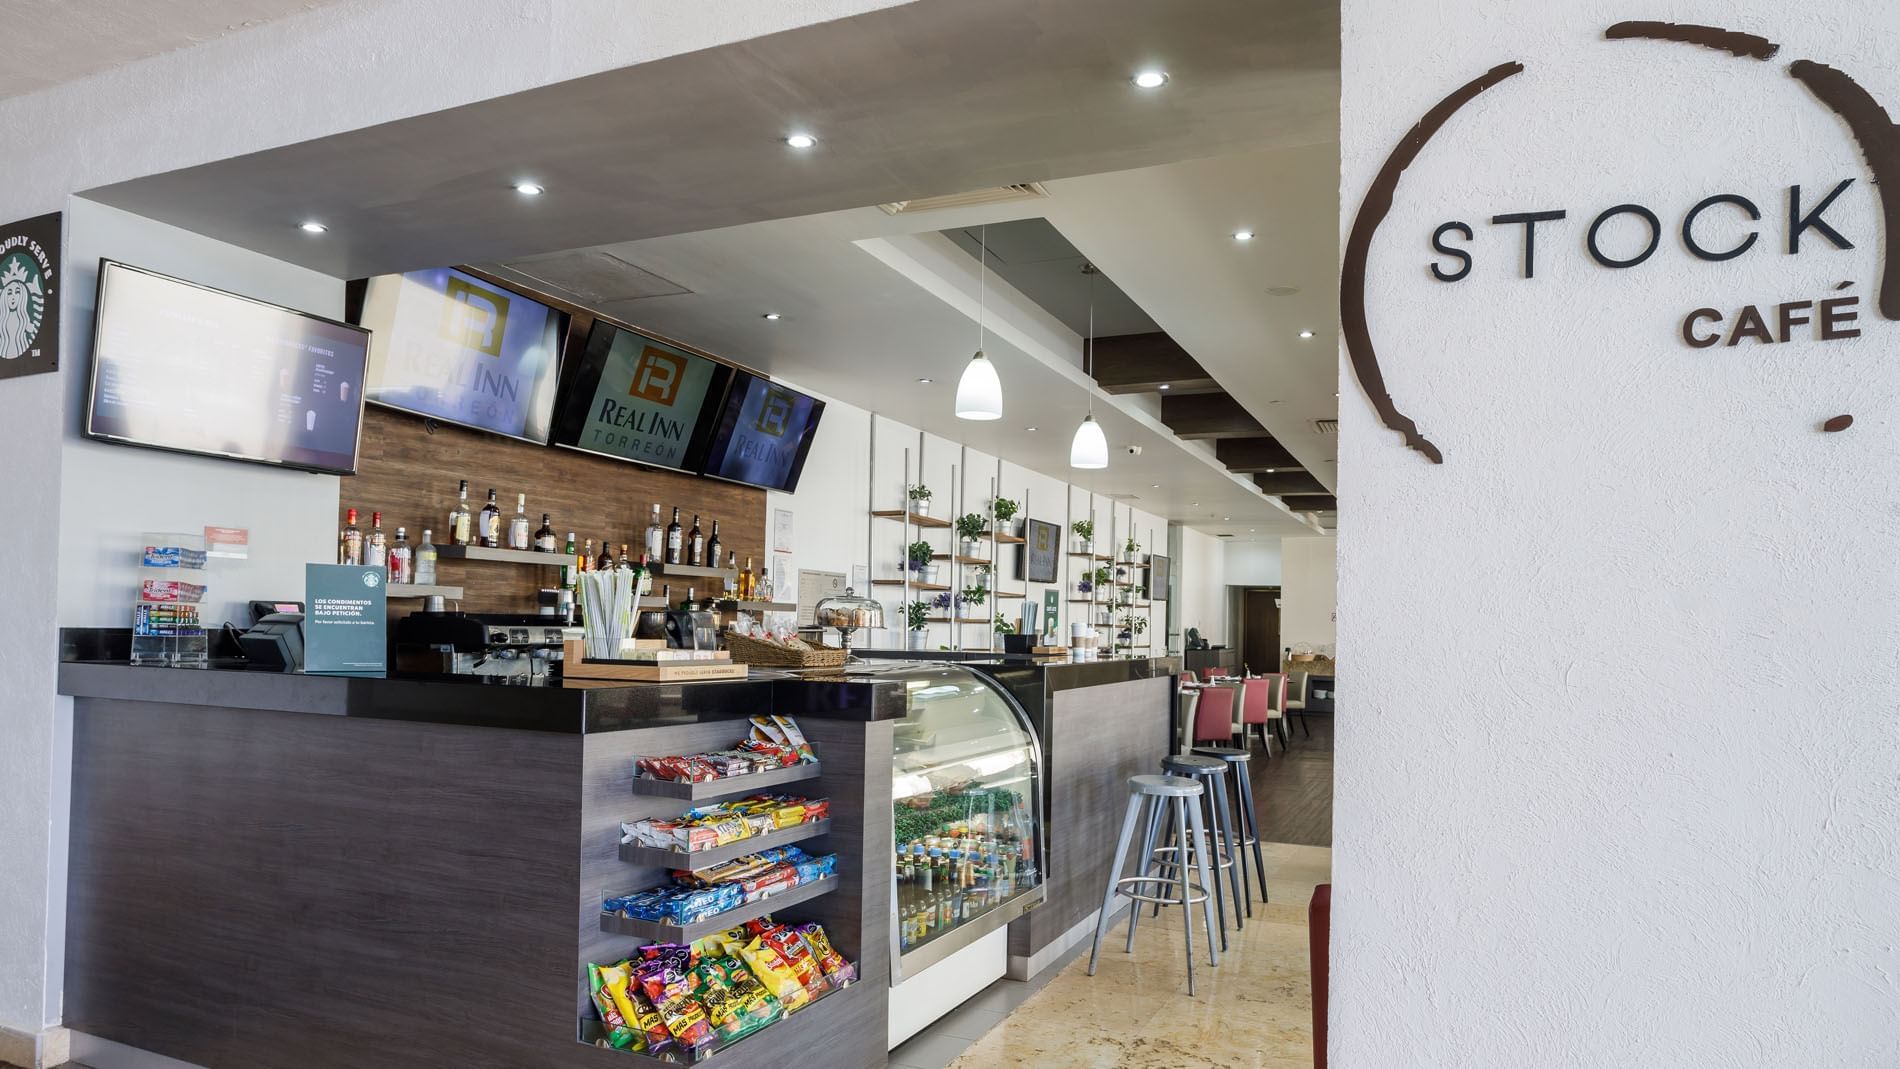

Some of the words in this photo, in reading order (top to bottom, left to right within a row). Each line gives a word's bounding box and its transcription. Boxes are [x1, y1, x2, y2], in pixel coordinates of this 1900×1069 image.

[1430, 178, 1857, 282] STOCK
[29, 240, 53, 280] SERVE
[1682, 280, 1861, 348] CAFÉ
[472, 361, 520, 402] INN
[598, 398, 646, 433] REAL
[648, 411, 685, 442] INN
[593, 428, 677, 460] TORREÓN
[735, 434, 766, 463] REAL
